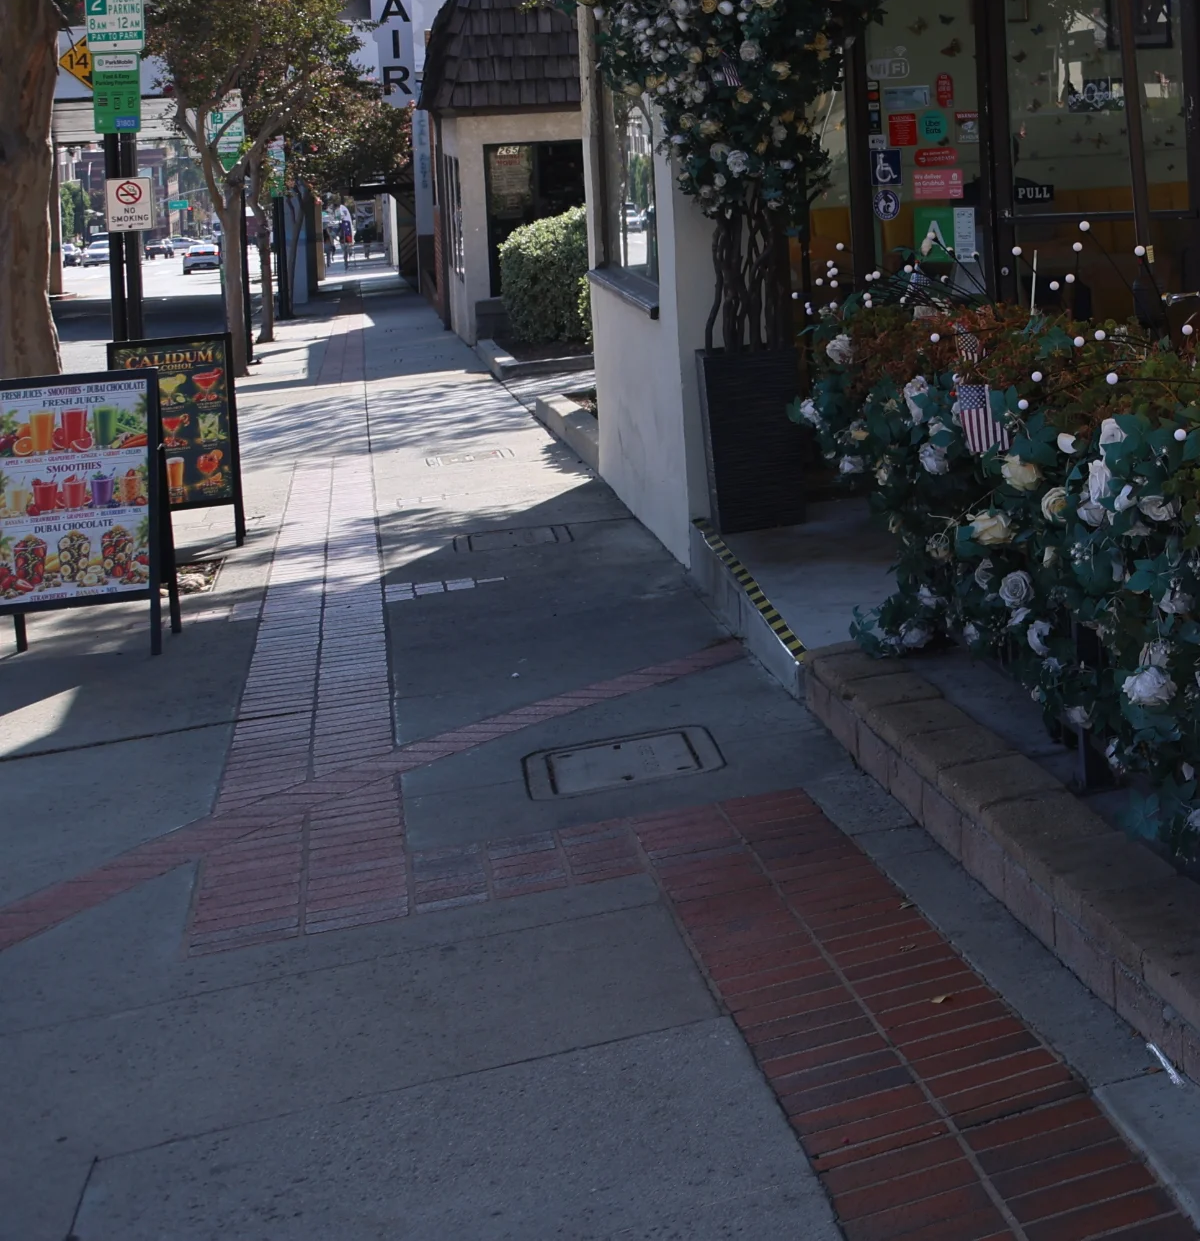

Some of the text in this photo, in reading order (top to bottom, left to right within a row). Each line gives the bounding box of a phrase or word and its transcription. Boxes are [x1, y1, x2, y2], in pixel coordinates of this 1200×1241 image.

[108, 3, 140, 14] PARKING
[120, 31, 138, 39] PARK
[499, 146, 518, 154] 265
[1018, 186, 1050, 199] PULL
[111, 214, 149, 223] SMOKING
[125, 350, 213, 369] CALIDUM
[159, 363, 194, 372] COHOL
[1, 381, 145, 400] FRESH JUICES SMOOTHIES DUBAI CHOCOLATE
[42, 395, 105, 407] FRESH JUICES
[46, 461, 102, 474] SMOOTHIES
[34, 519, 114, 534] DUBAI CHOCOLATE
[30, 592, 68, 602] STRAWBERRY
[75, 589, 99, 597] BANANA
